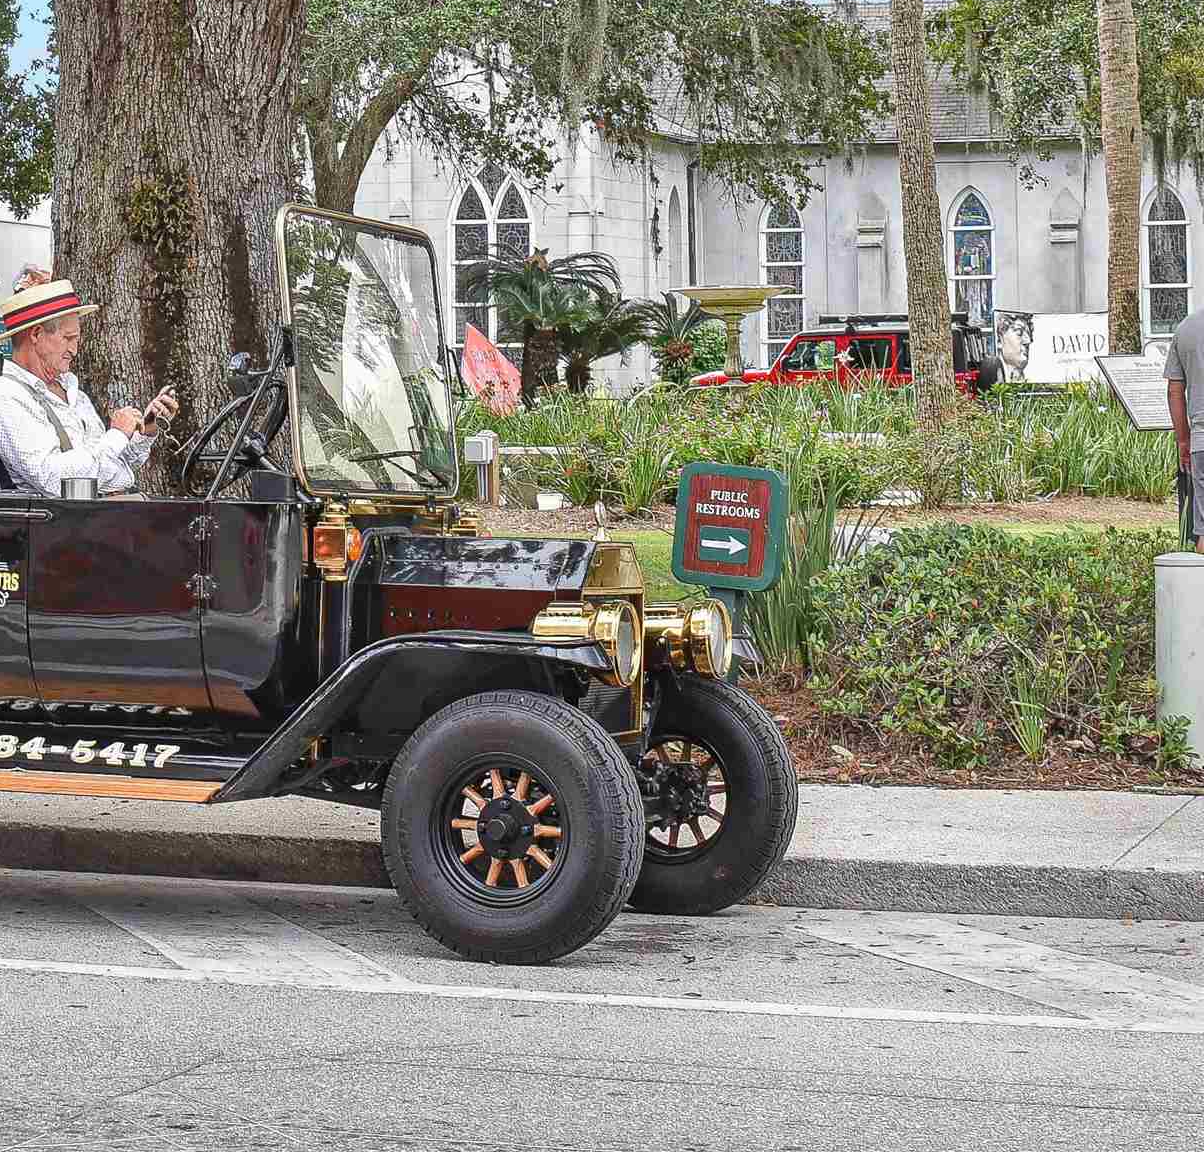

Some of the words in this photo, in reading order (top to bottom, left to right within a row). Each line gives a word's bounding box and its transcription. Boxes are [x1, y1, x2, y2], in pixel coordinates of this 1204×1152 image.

[1052, 334, 1105, 354] DAVID
[710, 490, 749, 504] PUBLIC
[696, 503, 761, 519] RESTROOMS
